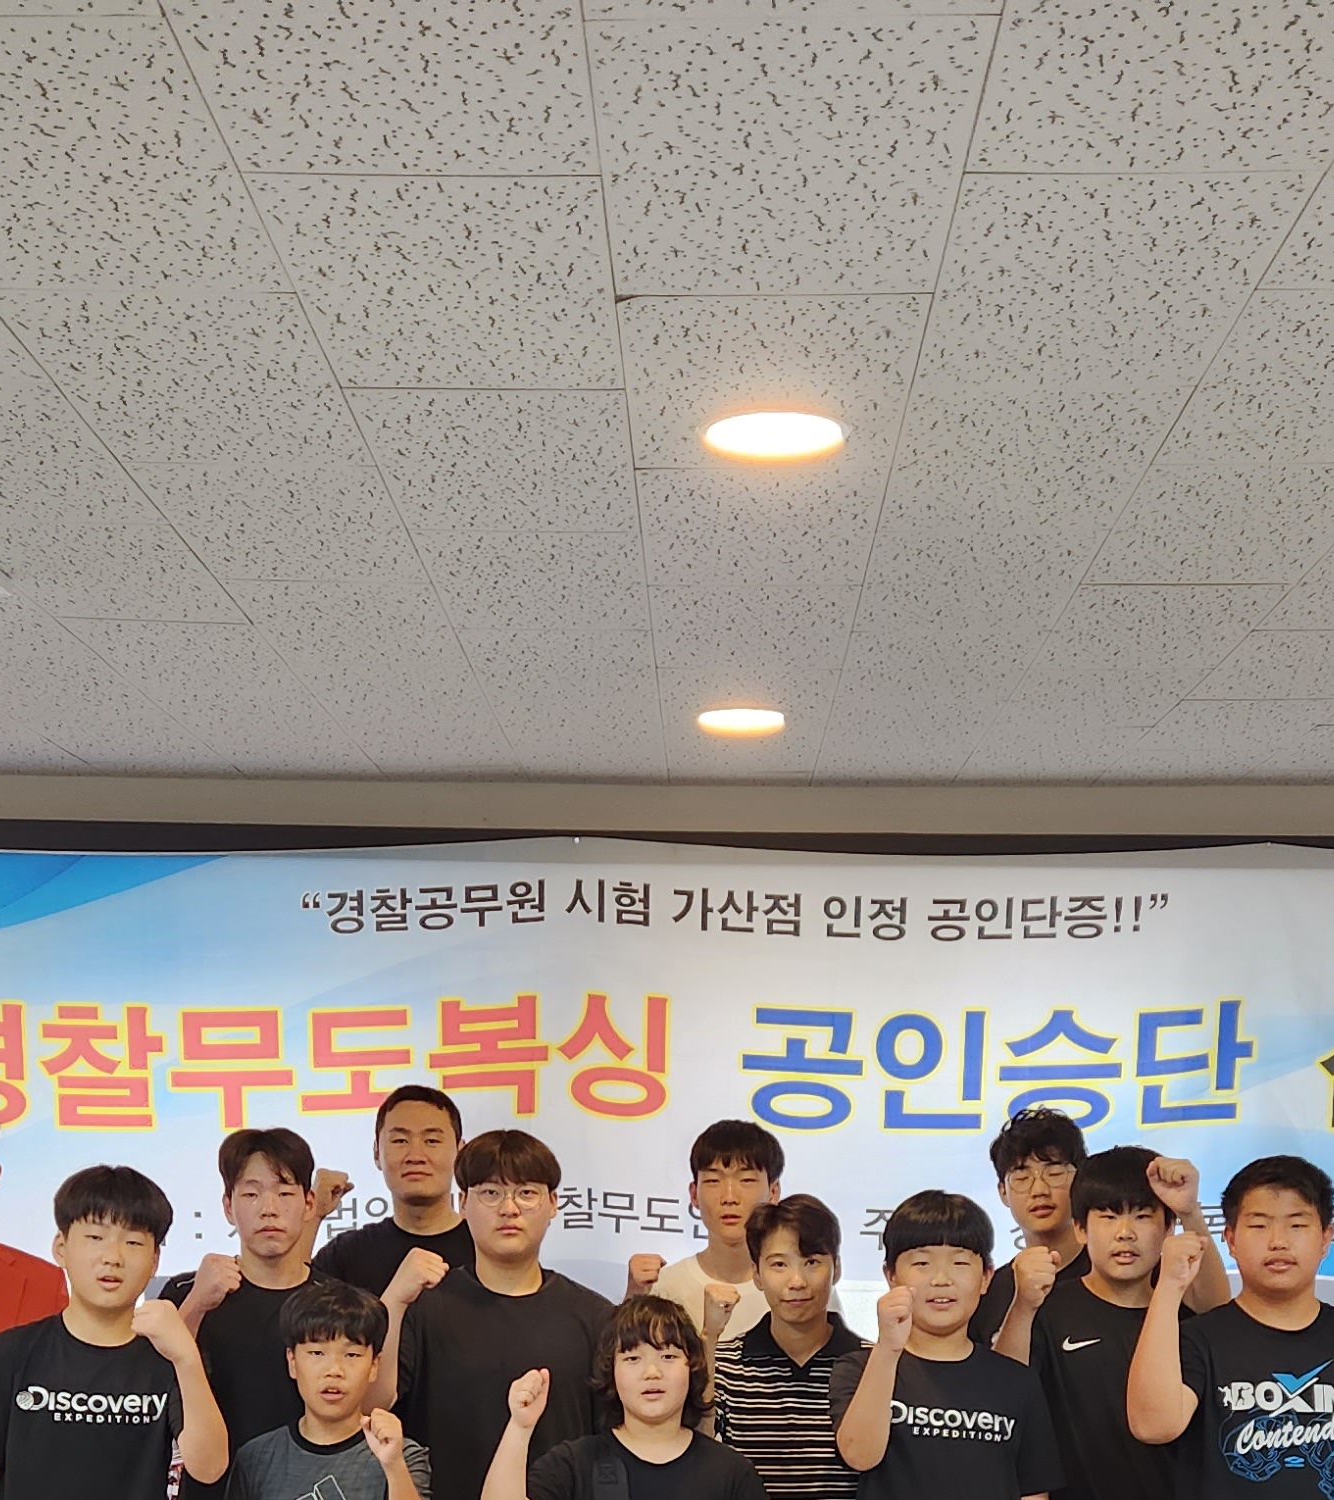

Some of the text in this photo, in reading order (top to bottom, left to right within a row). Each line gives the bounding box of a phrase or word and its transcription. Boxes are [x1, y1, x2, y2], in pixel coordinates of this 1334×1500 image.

[566, 879, 653, 928] 시험
[670, 888, 805, 938] 가산점
[822, 892, 909, 942] 인정
[739, 1000, 1255, 1134] 공인승단
[54, 1413, 150, 1424] EXPEDITION
[913, 1427, 1001, 1442] EXPEDITION
